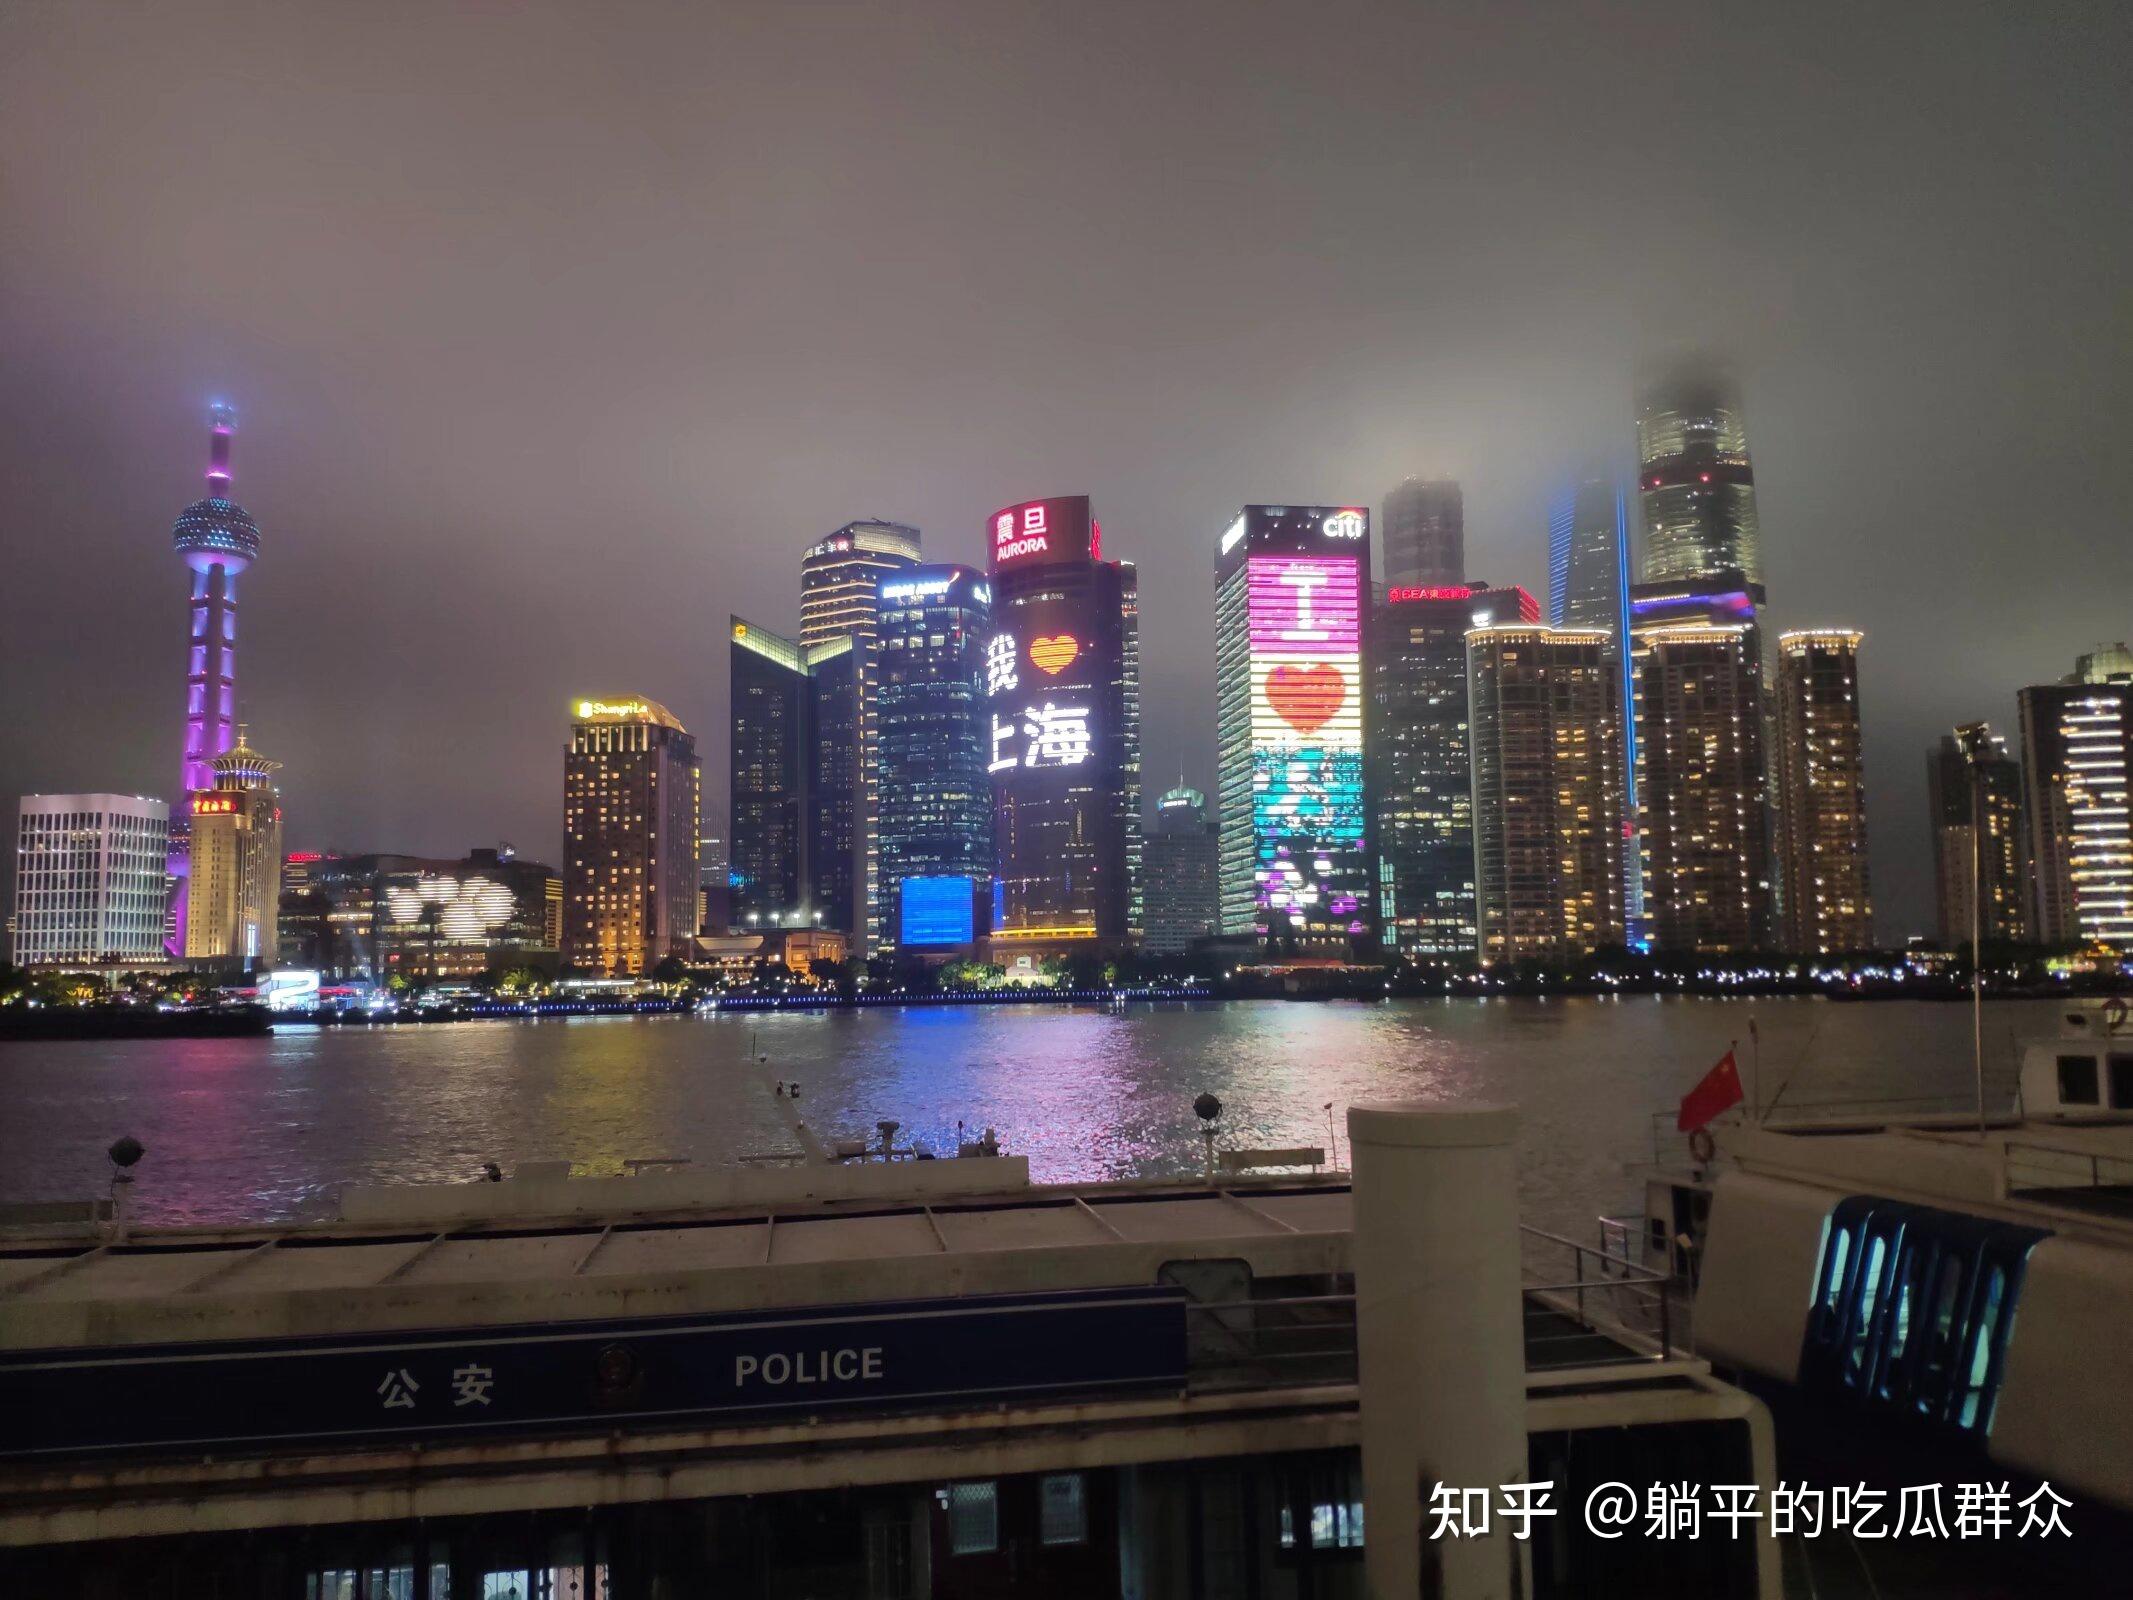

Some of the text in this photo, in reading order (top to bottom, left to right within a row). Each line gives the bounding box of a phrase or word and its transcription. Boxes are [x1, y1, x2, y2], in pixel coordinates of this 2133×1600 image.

[997, 506, 1047, 545] 震旦
[1322, 512, 1363, 538] citi
[997, 537, 1048, 562] AURORA
[1279, 571, 1329, 641] I
[986, 634, 1019, 697] 我
[987, 702, 1091, 774] 上海
[377, 1363, 494, 1408] 公安
[735, 1347, 883, 1387] POLICE
